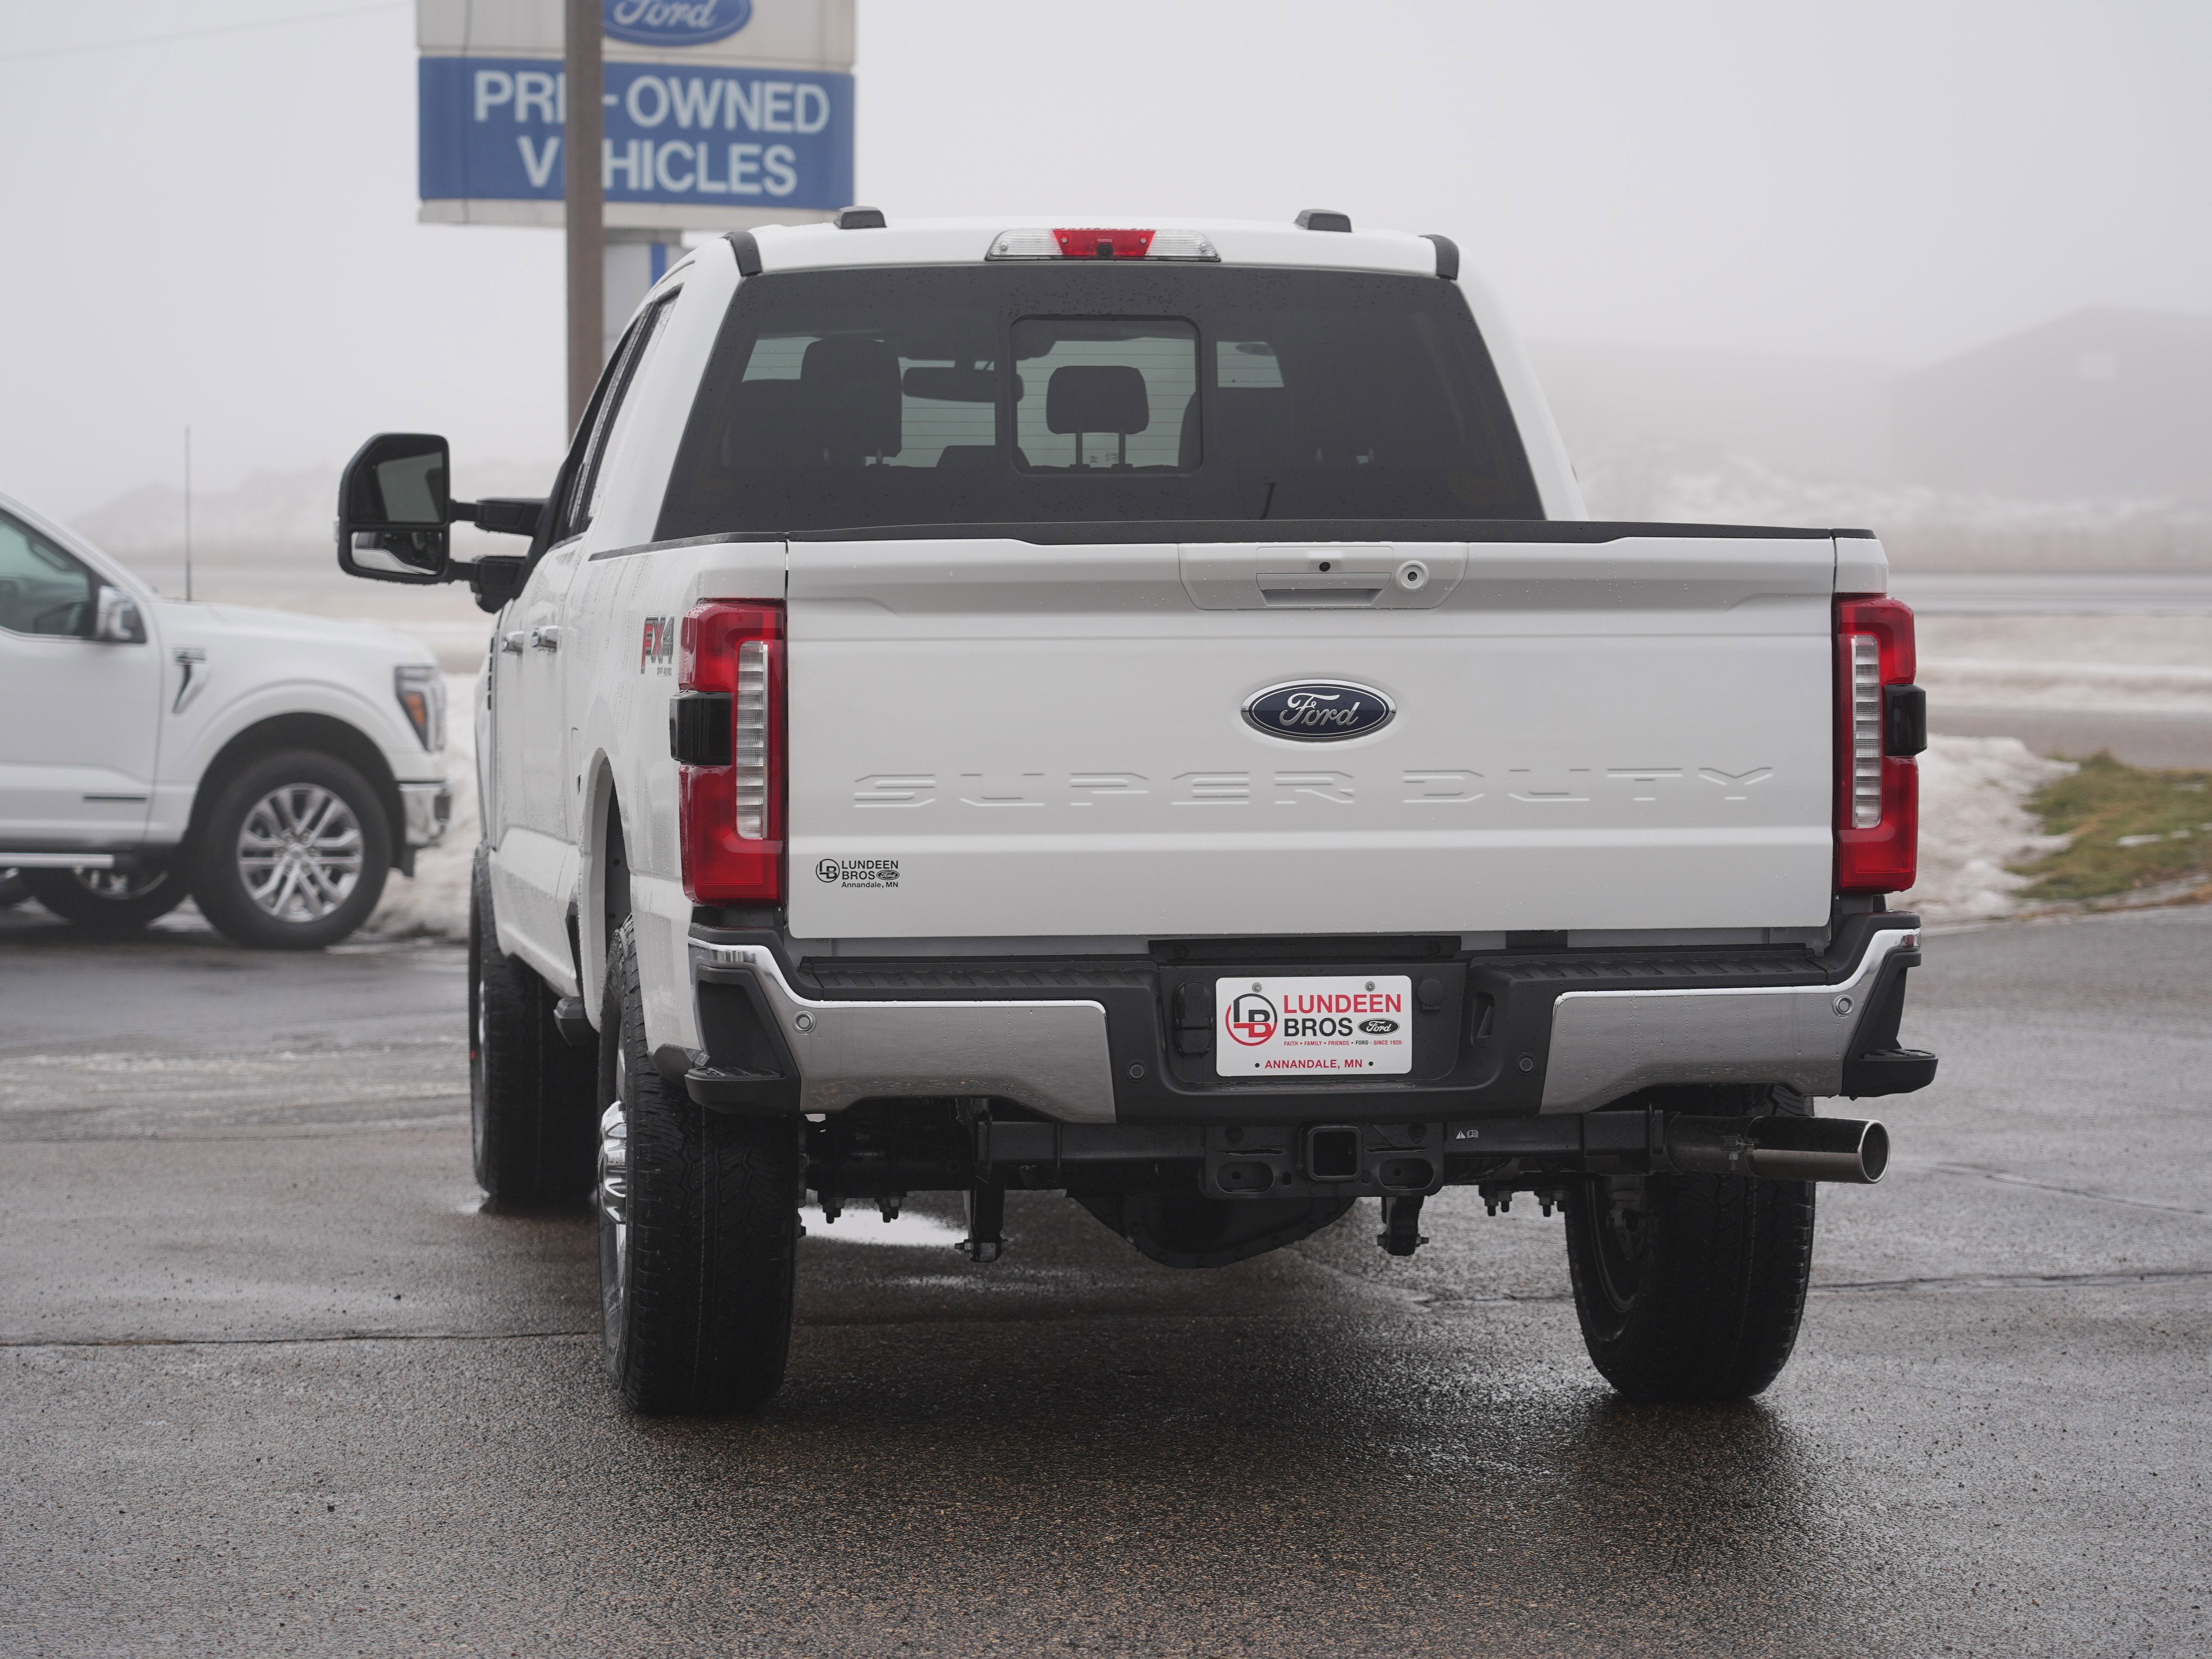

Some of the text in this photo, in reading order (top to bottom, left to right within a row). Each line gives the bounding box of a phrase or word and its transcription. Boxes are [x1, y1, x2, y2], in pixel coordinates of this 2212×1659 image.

[517, 136, 798, 196] VHICLES
[640, 616, 675, 675] FX4
[1279, 692, 1361, 726] Ford
[854, 767, 1775, 808] SUPER DUTY
[841, 860, 899, 869] LUNDEEN
[841, 871, 875, 880] BROS
[1284, 994, 1401, 1014] LUNDEEN
[1284, 1017, 1353, 1037] BROS
[1365, 1020, 1392, 1032] Ford
[1265, 1060, 1363, 1069] ANNANDALE, MN
